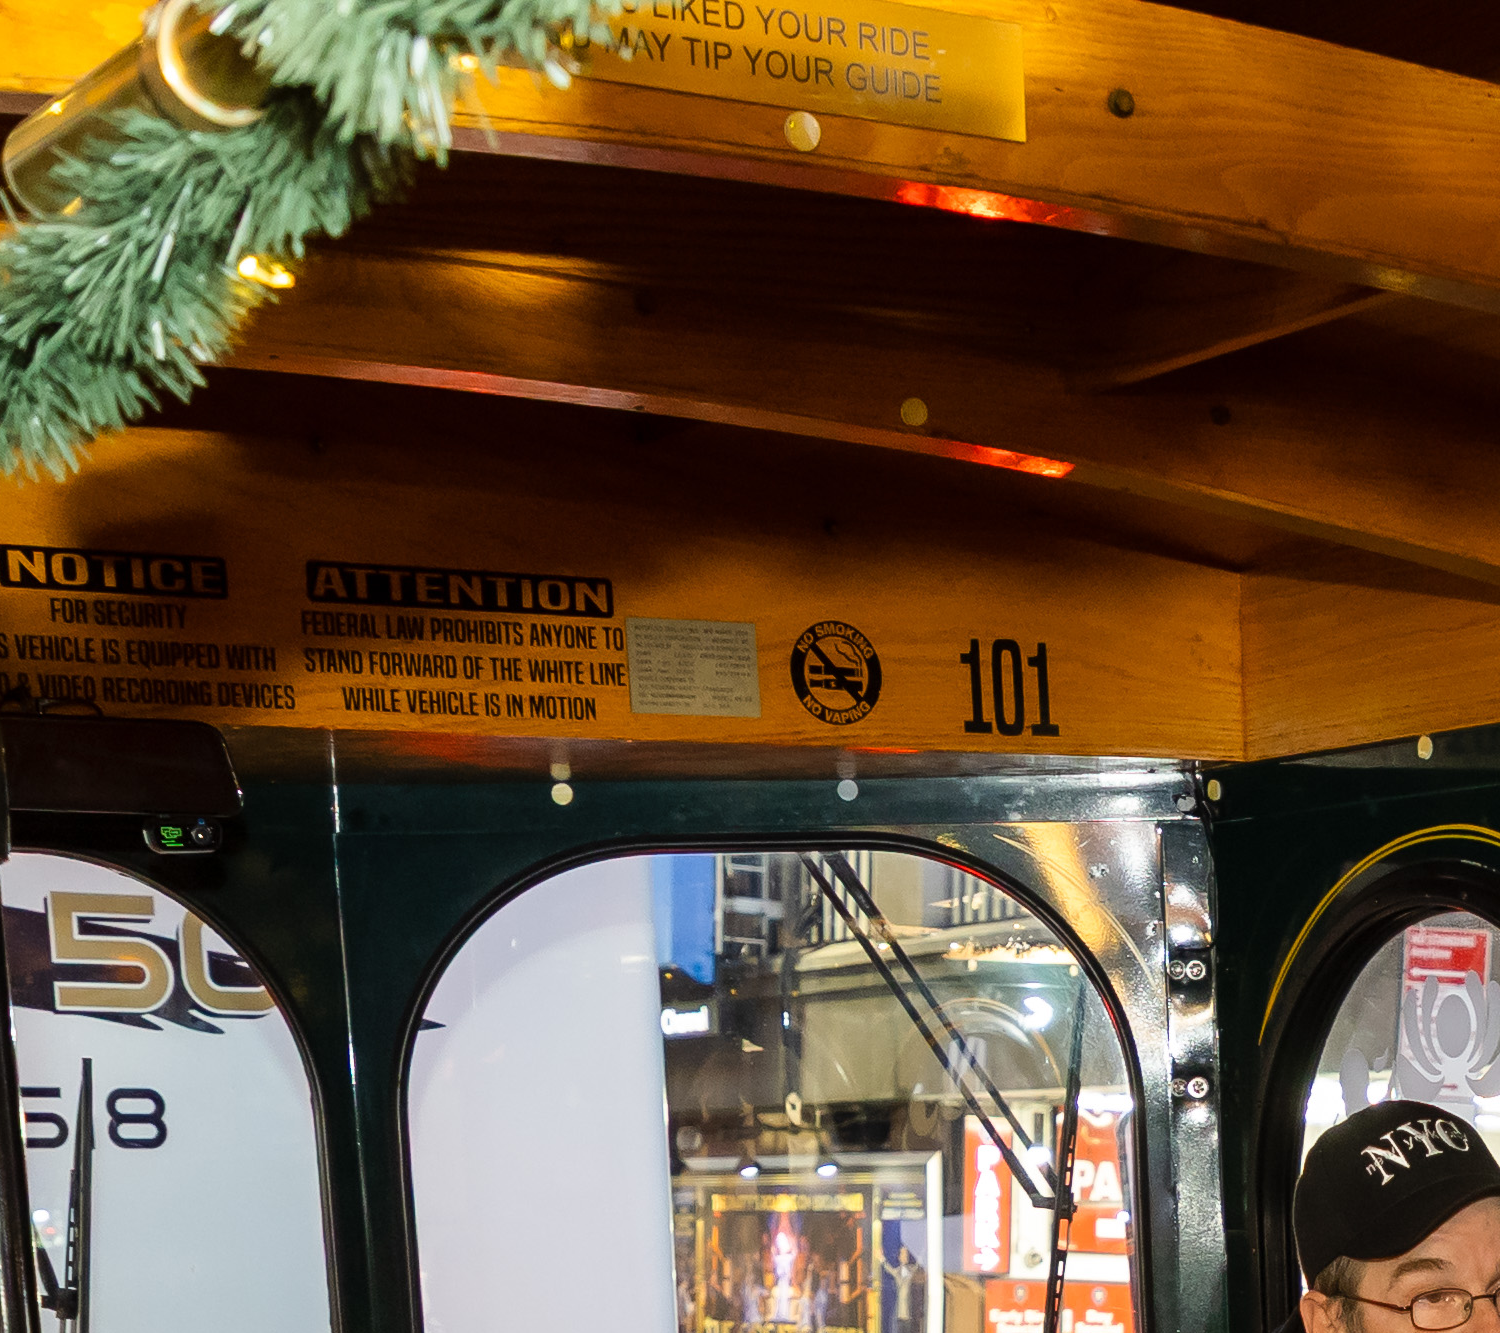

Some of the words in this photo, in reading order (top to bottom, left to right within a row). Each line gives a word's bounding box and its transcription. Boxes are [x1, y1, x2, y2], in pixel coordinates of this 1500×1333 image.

[653, 0, 745, 30] LIKED
[757, 6, 847, 47] YOUR
[858, 22, 931, 61] RIDE
[681, 36, 732, 70] TIP
[743, 45, 835, 87] YOUR
[845, 62, 942, 103] GUIDE
[6, 549, 223, 594] NOTICE
[312, 566, 609, 613] ATTENTION
[50, 598, 88, 624] FOR
[94, 601, 186, 630] SECURITY
[301, 610, 381, 639] FEDERAL
[386, 614, 425, 641] LAW
[430, 618, 523, 646] PROHIBITS
[529, 623, 597, 650] ANYONE
[602, 626, 624, 651] TO
[14, 634, 97, 664] VEHICLE
[102, 637, 121, 665] IS
[127, 640, 220, 671] EQUIPPED
[225, 643, 277, 672] WITH
[797, 631, 815, 653] NO
[815, 622, 875, 660] SMOKING
[304, 647, 363, 674] STAND
[369, 651, 457, 679] FORWARD
[463, 655, 484, 680] OF
[489, 657, 523, 682] THE
[528, 659, 585, 686] WHITE
[589, 662, 627, 687] LINE
[37, 673, 97, 701] VIDEO
[102, 677, 212, 707] RECORDING
[217, 681, 296, 710] DEVICES
[341, 686, 401, 712] WHILE
[405, 690, 477, 716] VEHICLE
[484, 693, 500, 717] IS
[506, 694, 524, 718] IN
[529, 695, 597, 721] MOTION
[959, 638, 1061, 737] 101
[803, 694, 822, 716] NO
[824, 701, 871, 724] VAPING
[1361, 1118, 1469, 1186] NYC
